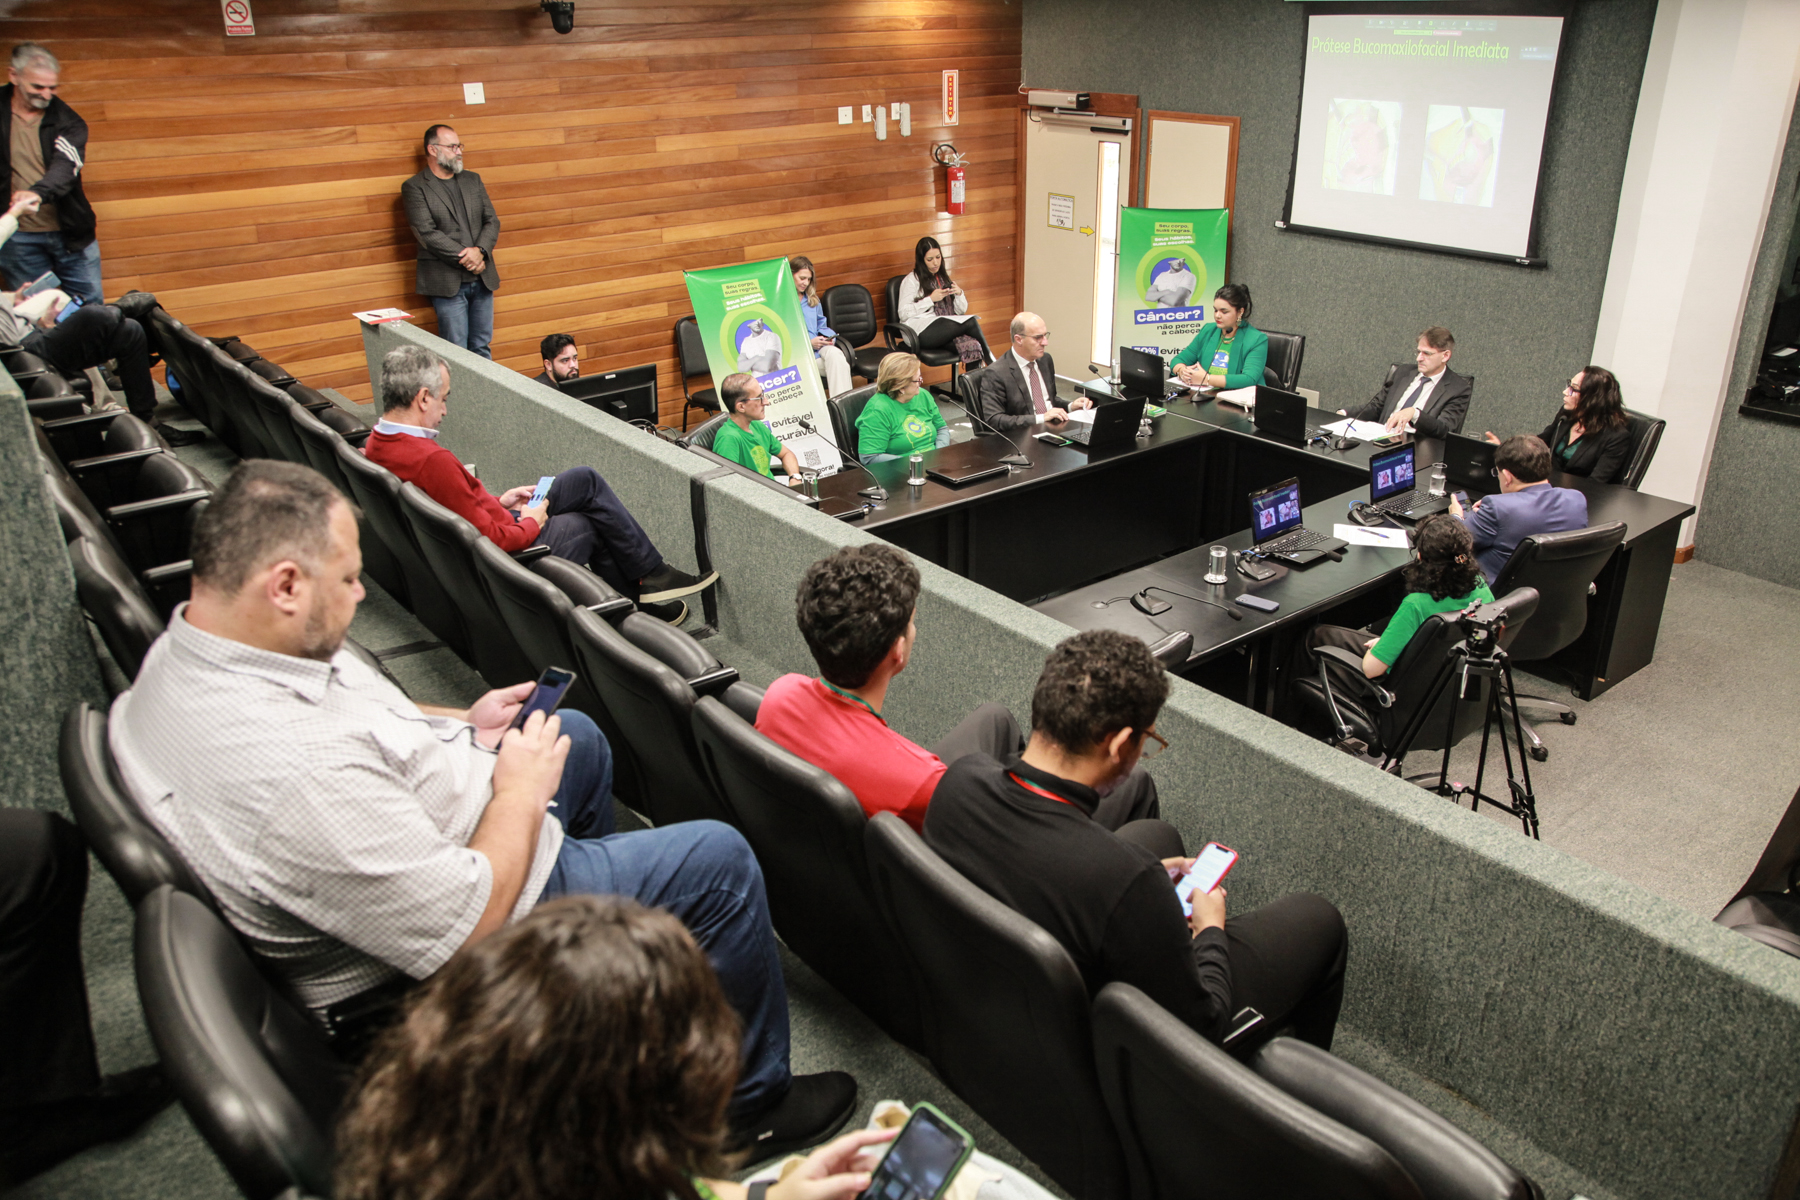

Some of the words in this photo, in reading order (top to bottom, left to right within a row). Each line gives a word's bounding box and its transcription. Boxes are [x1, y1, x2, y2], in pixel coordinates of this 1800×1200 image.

[1311, 36, 1351, 54] Prótese
[1352, 37, 1450, 57] Bucomaxilofacial
[1452, 40, 1510, 60] Imediata
[758, 370, 797, 391] ncer?
[772, 390, 804, 405] cabeça
[776, 384, 802, 398] perca
[771, 411, 814, 429] evitável
[776, 424, 818, 442] curável
